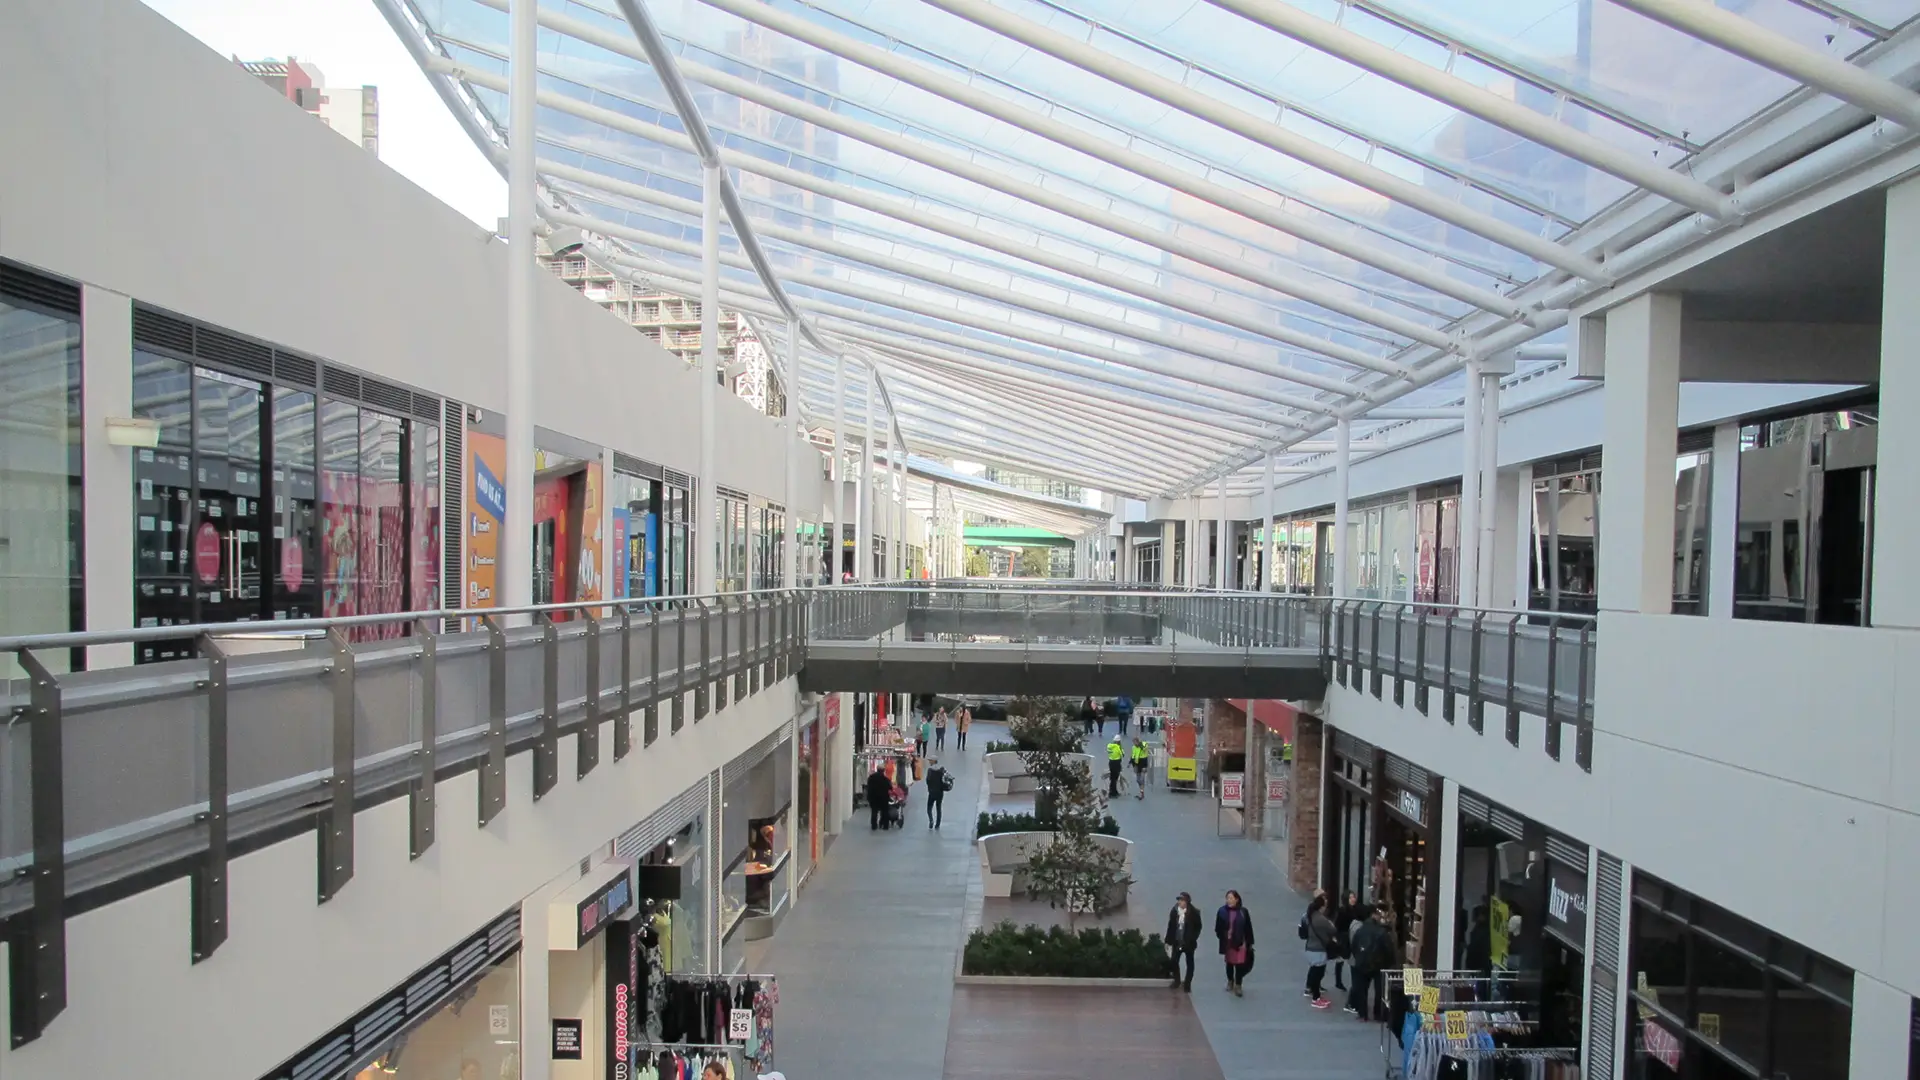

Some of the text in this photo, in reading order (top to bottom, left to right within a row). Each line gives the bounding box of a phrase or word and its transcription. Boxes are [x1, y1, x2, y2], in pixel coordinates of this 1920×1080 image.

[616, 983, 628, 1061] accessories
[732, 1012, 750, 1020] TOPS
[732, 1022, 748, 1032] $5
[1447, 1019, 1465, 1035] $20
